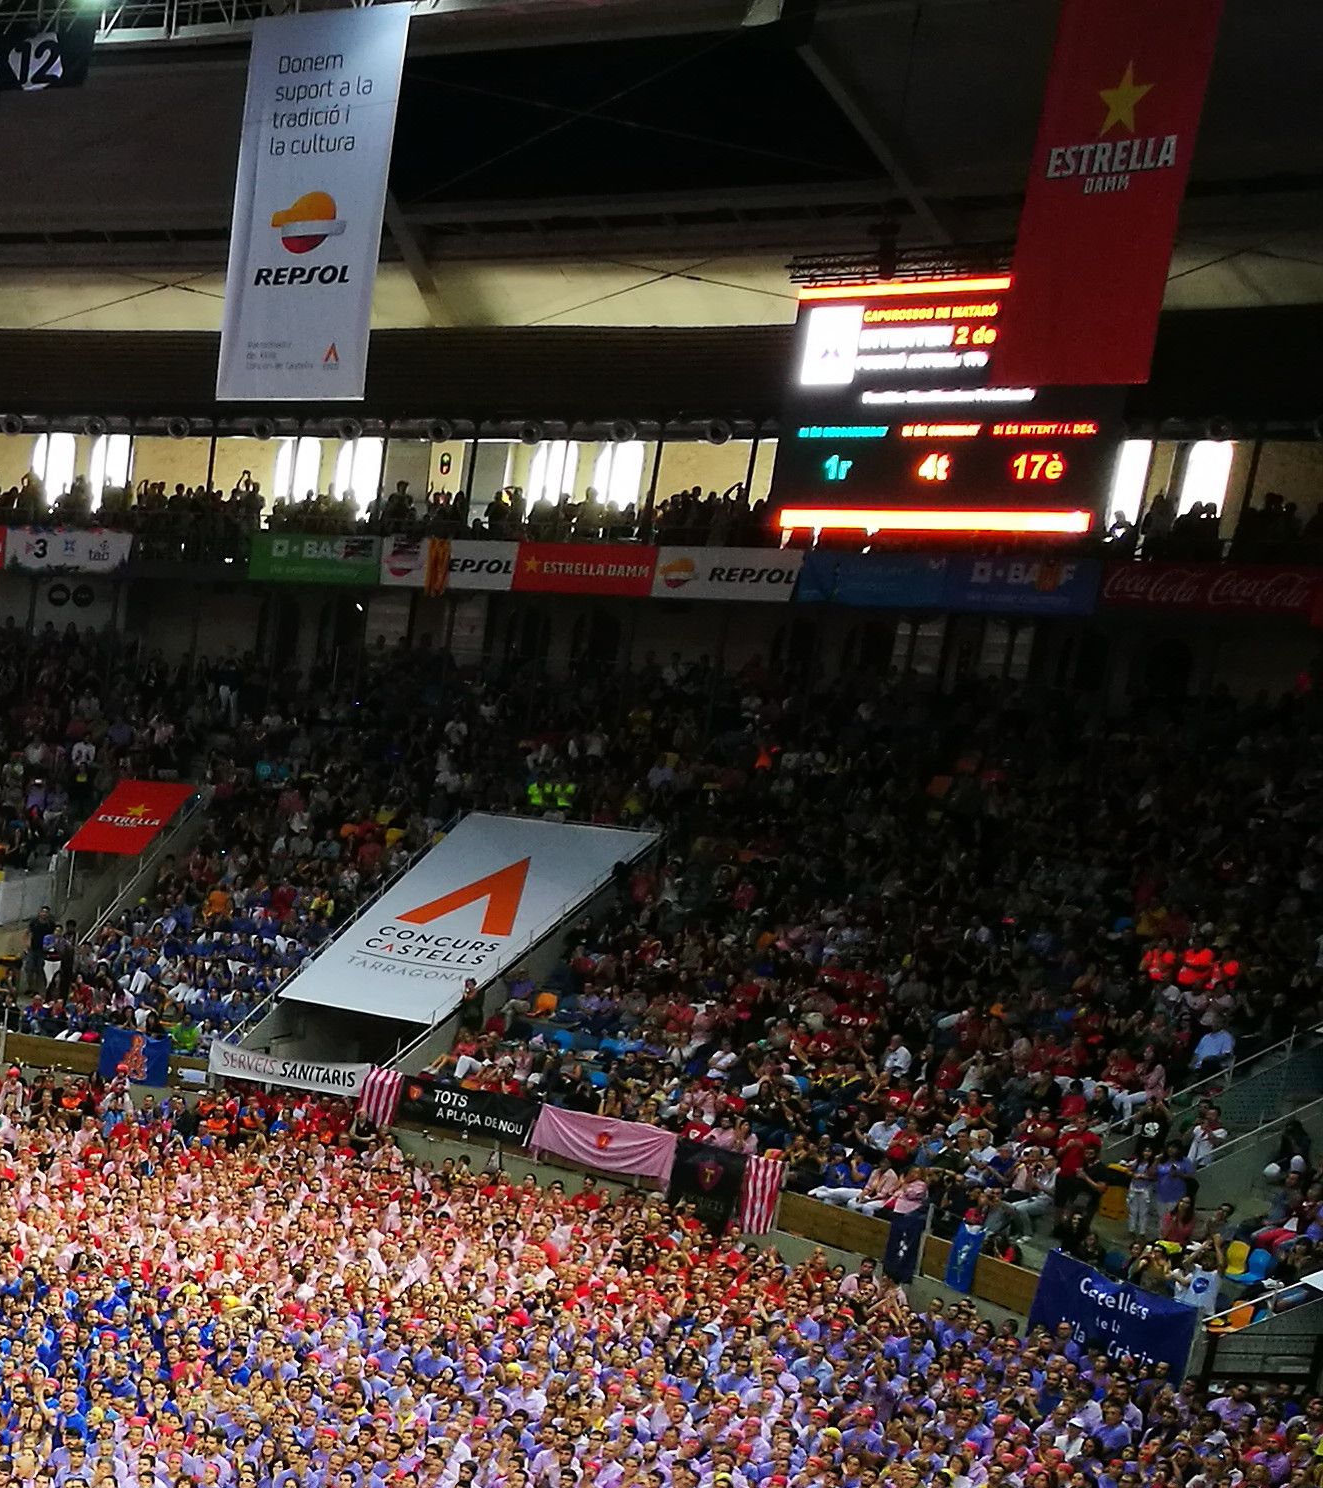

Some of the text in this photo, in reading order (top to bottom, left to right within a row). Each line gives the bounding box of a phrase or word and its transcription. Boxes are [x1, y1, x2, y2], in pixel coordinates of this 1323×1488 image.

[278, 53, 344, 73] Donem
[275, 76, 373, 103] suport a la
[273, 104, 351, 128] tradició i
[270, 134, 355, 156] la cultura
[1046, 135, 1178, 179] ESTRELLA
[1083, 174, 1130, 194] DAMM
[254, 265, 350, 286] REPSOL
[955, 326, 969, 345] 2
[972, 326, 997, 345] de
[824, 455, 853, 480] 1r
[918, 454, 951, 481] 4t
[1013, 454, 1064, 480] 17è
[33, 538, 47, 559] 3
[449, 558, 513, 574] EPSOL
[542, 561, 650, 578] ESTRELLA DAMM
[708, 566, 796, 585] REPSOL
[98, 814, 160, 826] ESTRELLA
[378, 926, 500, 952] CONCURS
[365, 938, 487, 965] CASTELLS
[347, 954, 463, 982] TARRAGONA
[221, 1051, 356, 1088] SERVEIS SANITARIS
[434, 1089, 469, 1108] TOTS
[437, 1108, 445, 1120] A
[446, 1110, 481, 1128] PLAÇA
[500, 1118, 523, 1135] NOU
